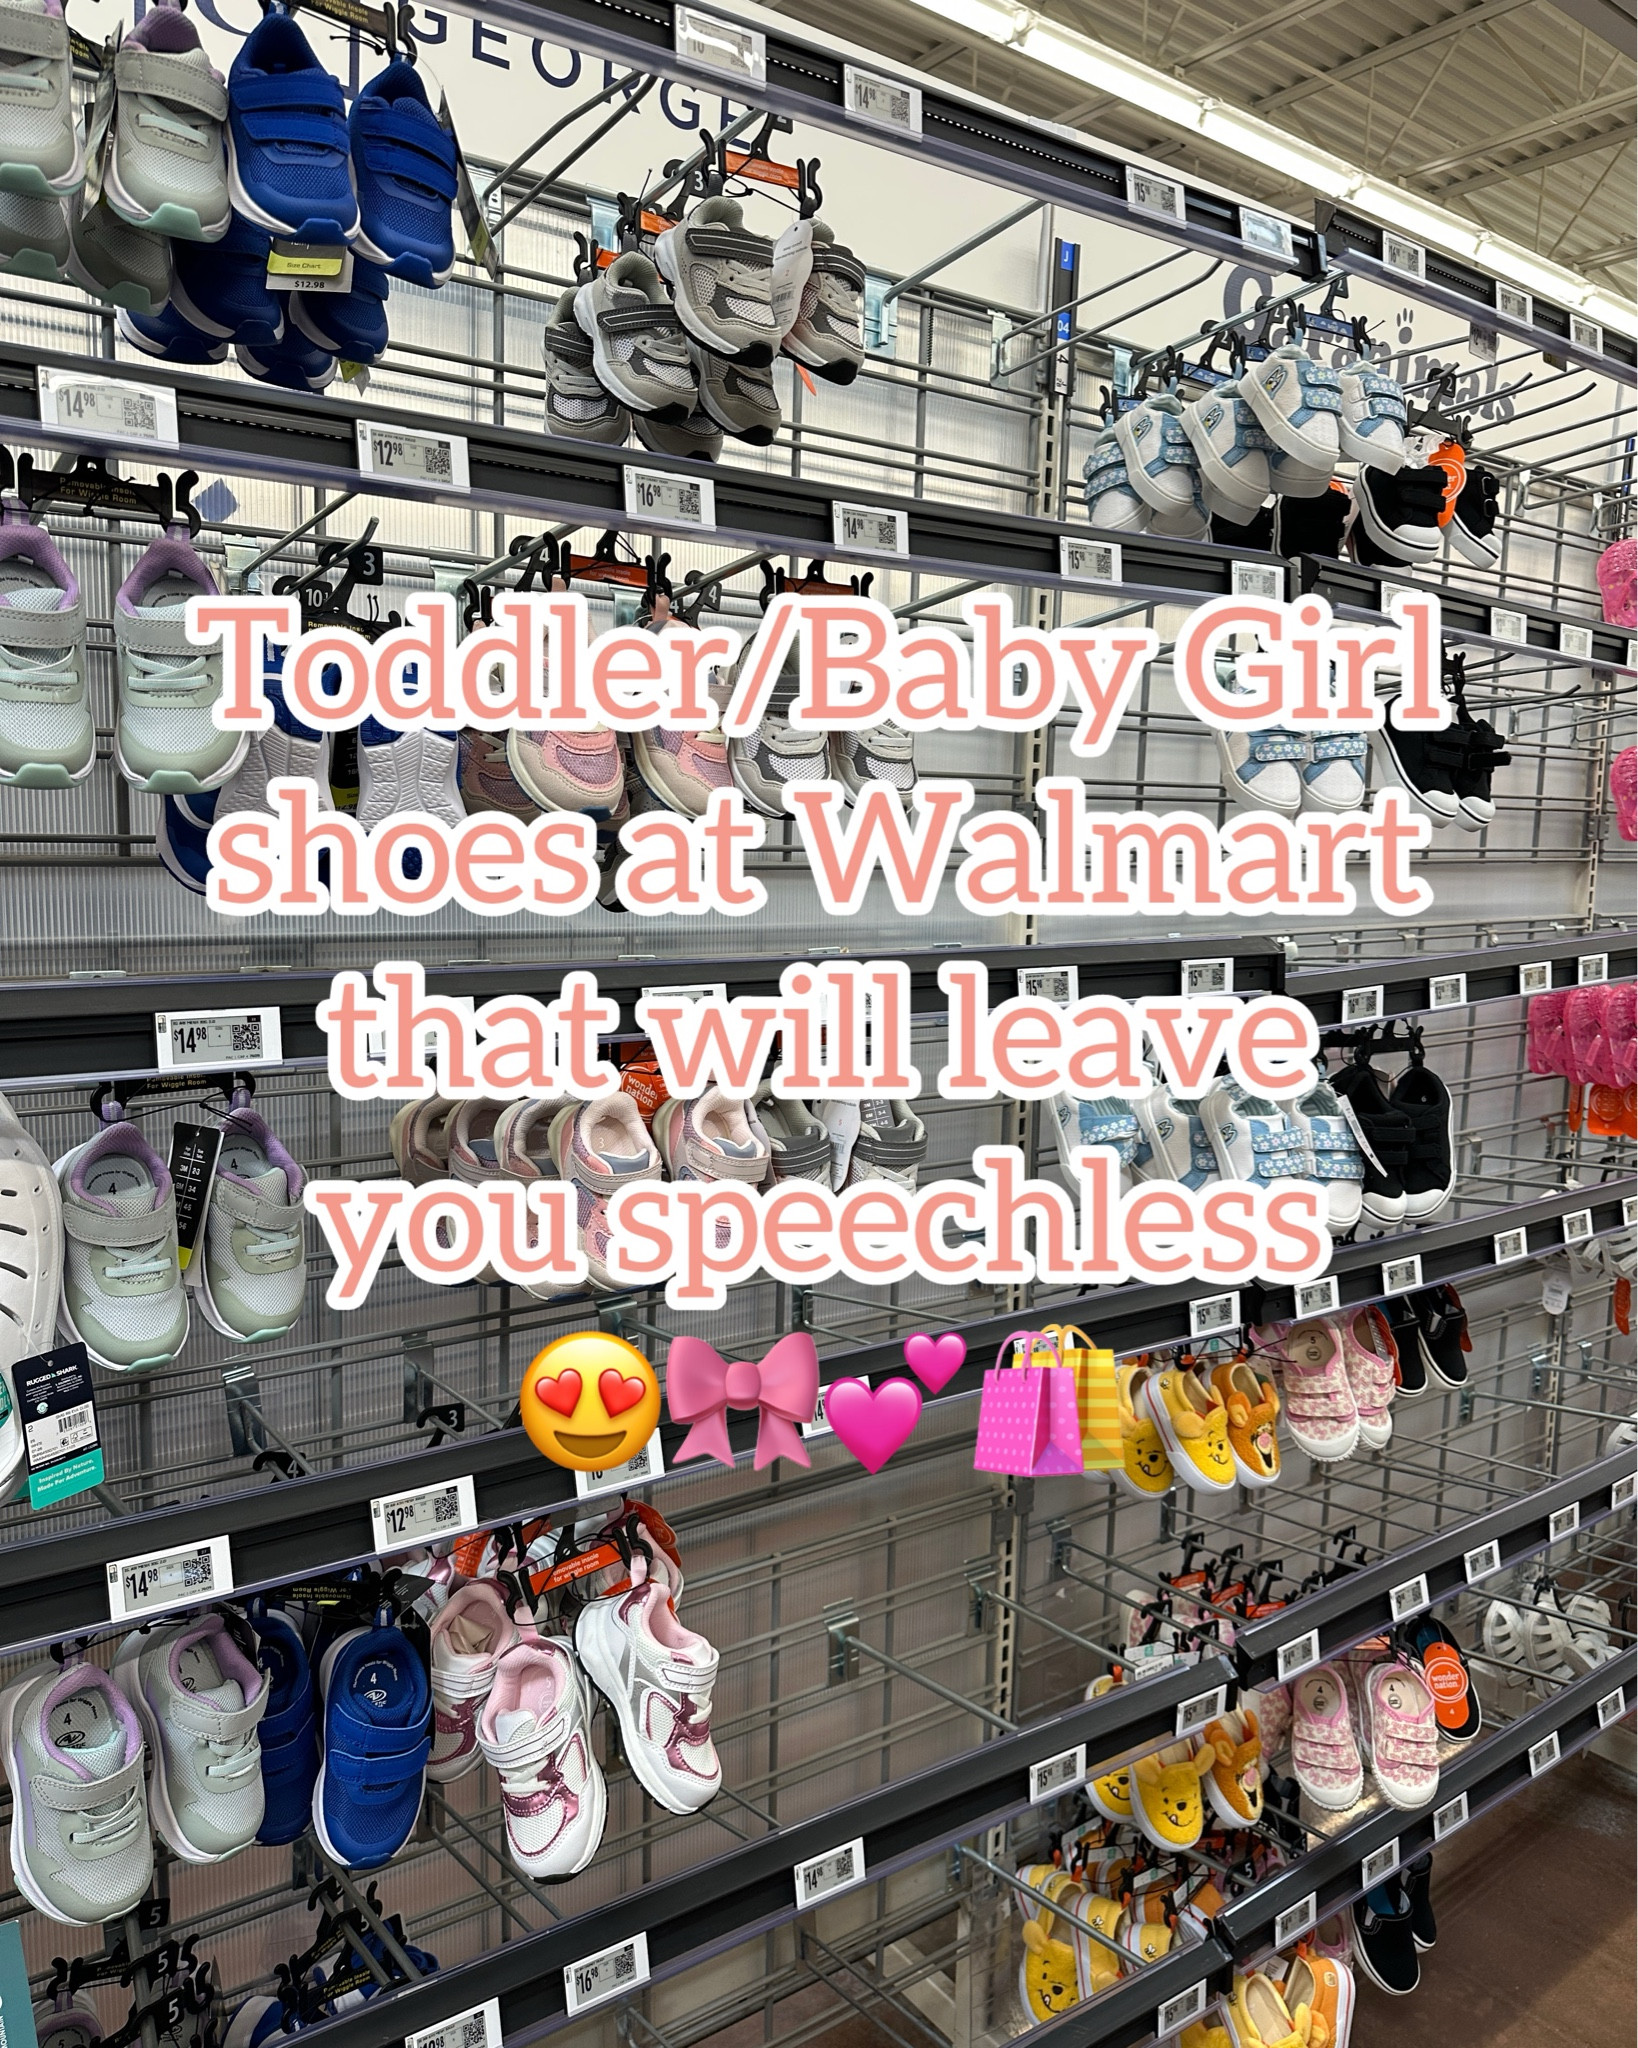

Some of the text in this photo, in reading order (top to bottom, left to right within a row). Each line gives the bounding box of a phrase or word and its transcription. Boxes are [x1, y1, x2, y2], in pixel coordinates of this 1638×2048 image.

[694, 170, 704, 191] 3
[1063, 249, 1071, 268] J
[294, 280, 325, 289] $12.98
[1057, 322, 1070, 335] 04
[60, 486, 75, 496] For
[112, 494, 137, 505] Room
[363, 552, 376, 576] 3
[709, 584, 717, 603] 4
[147, 1078, 206, 1090] For Wiggle Room
[231, 1158, 238, 1170] 4
[108, 1182, 117, 1195] 4
[1310, 1336, 1316, 1344] 5
[26, 1373, 51, 1387] RUGGED
[56, 1364, 78, 1377] SHARK
[449, 1409, 458, 1428] 3
[28, 1424, 34, 1433] 2
[287, 1459, 299, 1475] 4
[39, 1467, 63, 1483] Inspired
[64, 1467, 72, 1475] By
[37, 1482, 54, 1492] Made
[54, 1477, 65, 1486] For
[581, 1553, 599, 1565] insole
[553, 1575, 563, 1583] for
[584, 1561, 600, 1570] room
[370, 1672, 377, 1685] 4
[1431, 1670, 1460, 1682] wonder
[1317, 1686, 1323, 1694] 4
[1389, 1684, 1395, 1692] 4
[63, 1712, 72, 1726] 4
[1244, 1863, 1252, 1878] 5
[150, 1905, 161, 1925] 5
[158, 1950, 168, 1974] 5
[168, 1997, 180, 2024] 5
